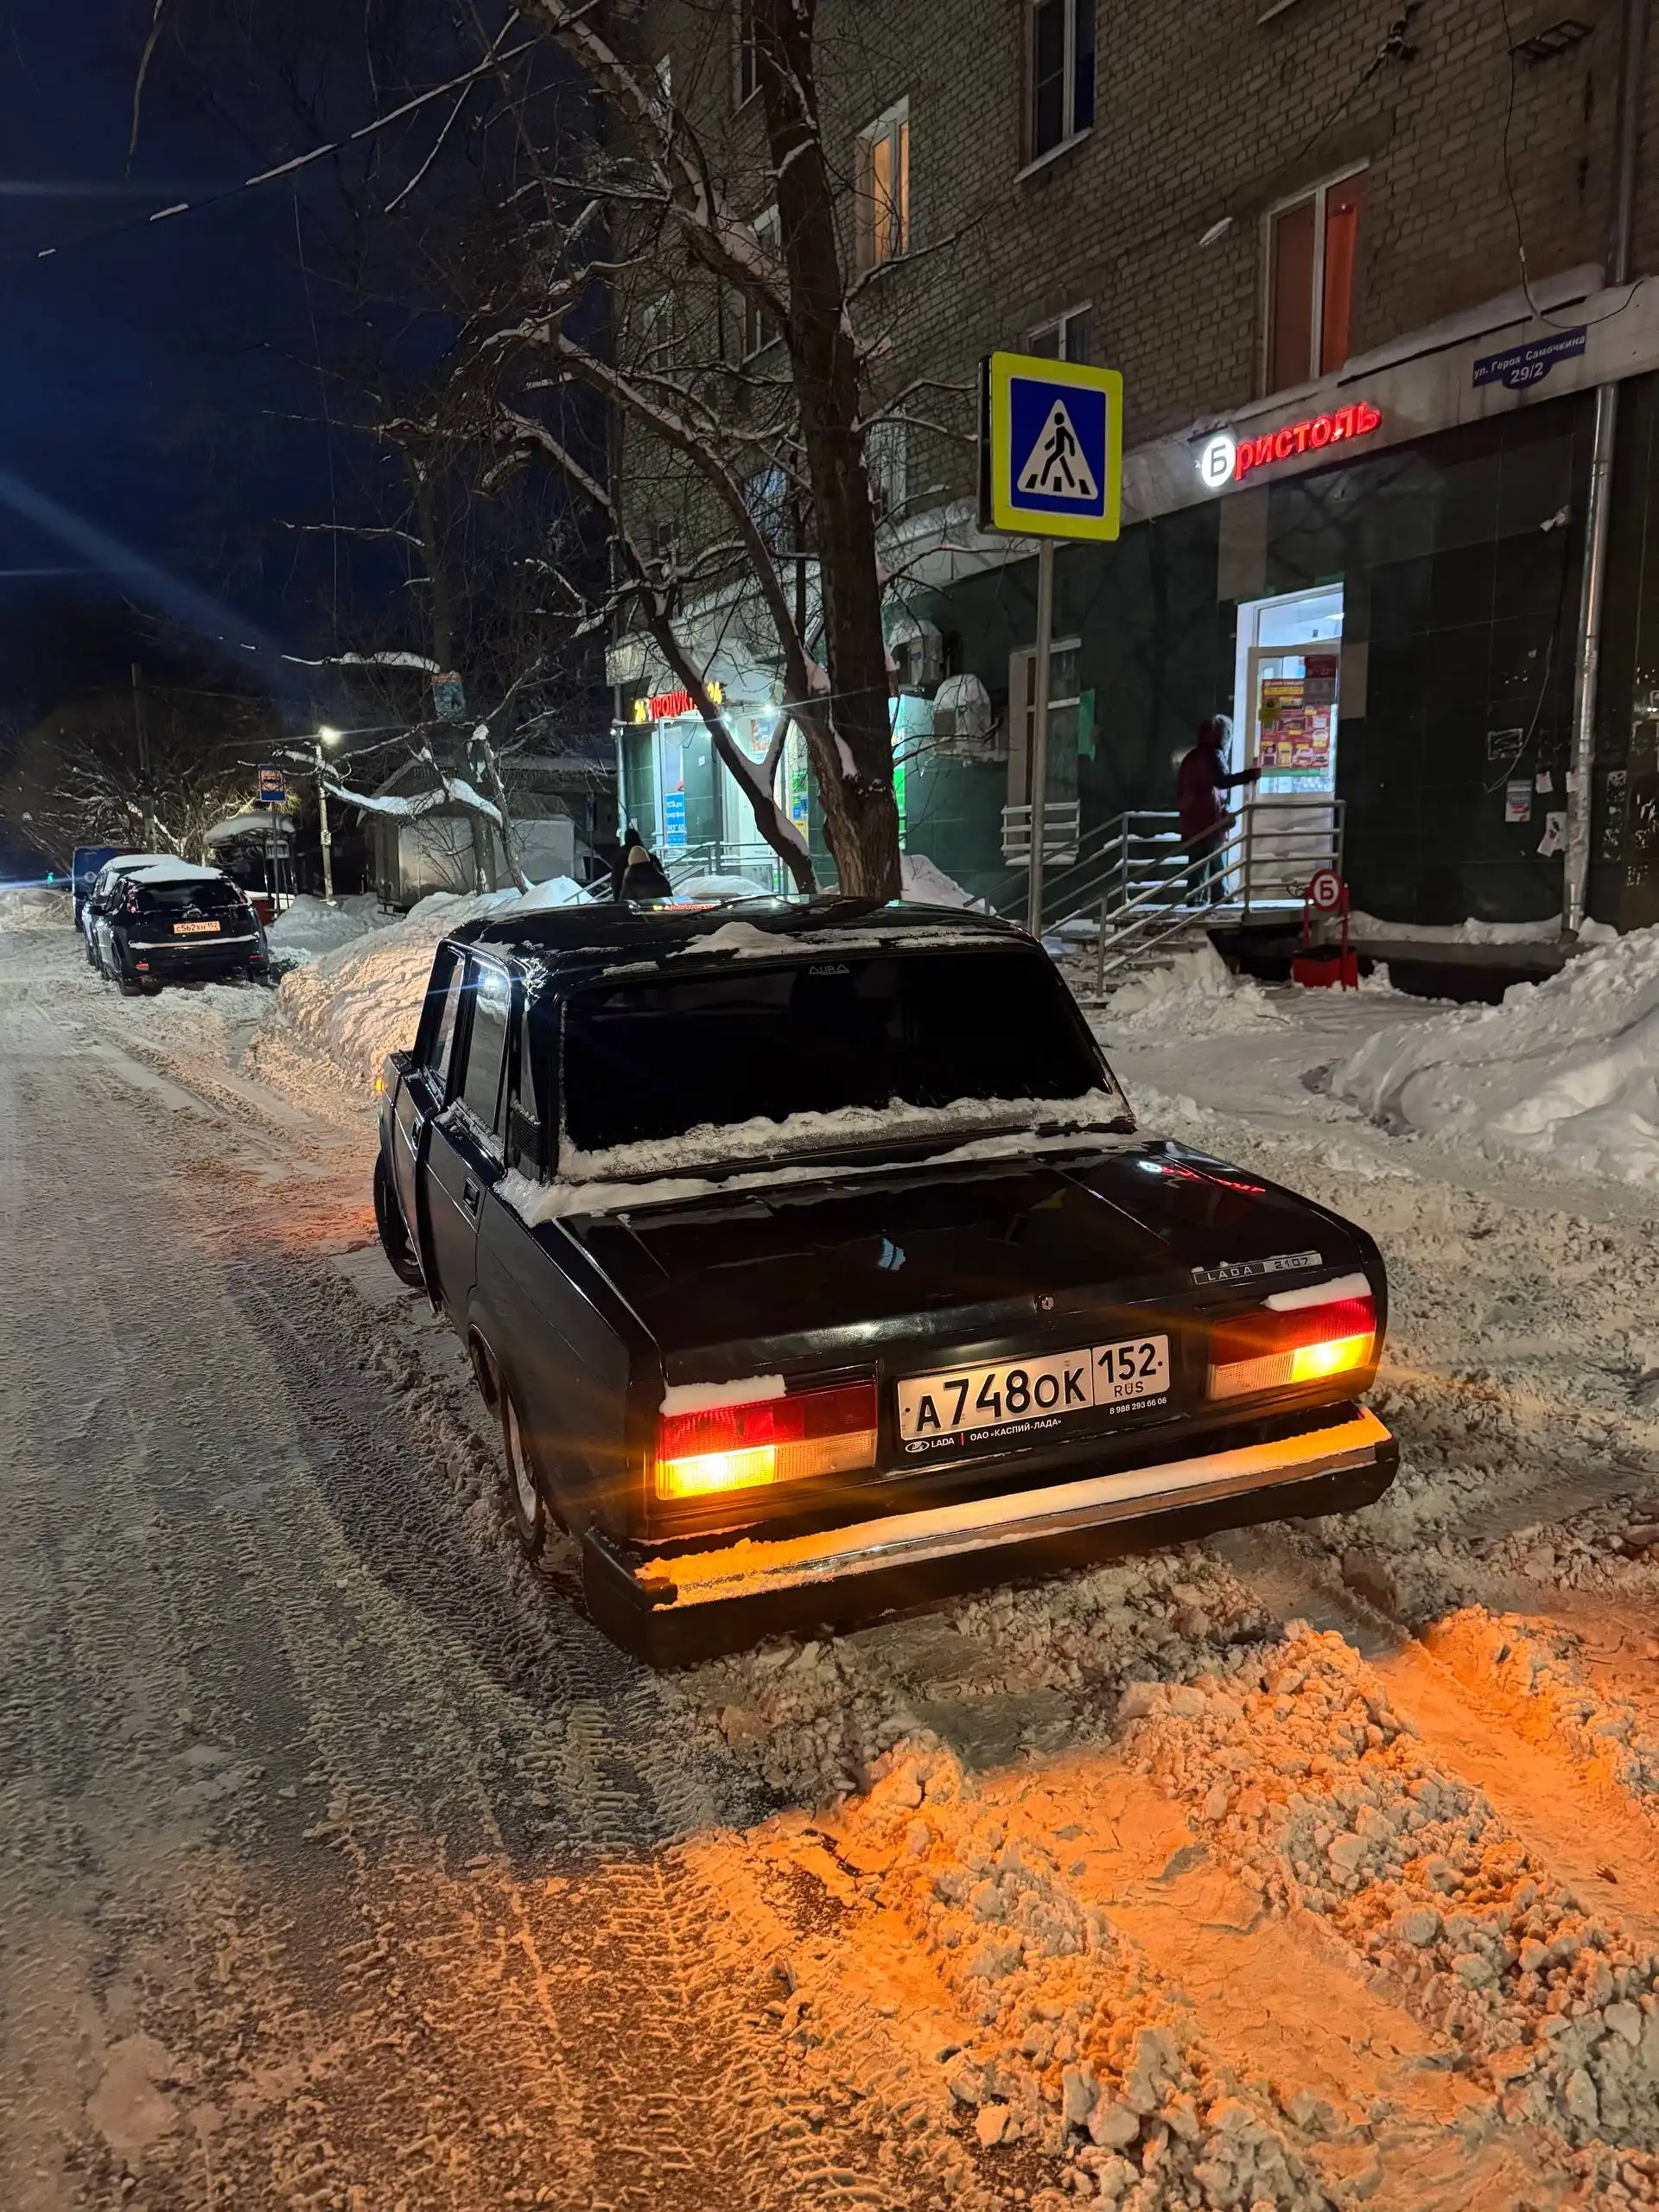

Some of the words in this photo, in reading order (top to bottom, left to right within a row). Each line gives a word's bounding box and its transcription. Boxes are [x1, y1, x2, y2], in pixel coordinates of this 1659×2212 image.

[1474, 367, 1489, 380] ул.
[1491, 355, 1521, 372] Героя
[1525, 334, 1586, 361] Самочкина
[1510, 361, 1544, 385] 29/2
[1210, 401, 1382, 481] Бристоль
[650, 690, 698, 721] ПРОДУК
[1319, 880, 1335, 900] Б
[1207, 1265, 1253, 1281] LADA
[1274, 1256, 1308, 1270] 2107
[916, 1367, 1087, 1433] А748ОК
[1097, 1343, 1157, 1383] 152
[1114, 1381, 1144, 1398] RUS
[1116, 1404, 1130, 1414] 988
[1131, 1401, 1146, 1410] 293
[1147, 1399, 1156, 1408] 66
[1157, 1396, 1167, 1405] 06
[969, 1431, 989, 1441] ОАО
[990, 1418, 1062, 1437] «КАСПИЙ-ЛАДА»
[931, 1437, 956, 1448] LADA
